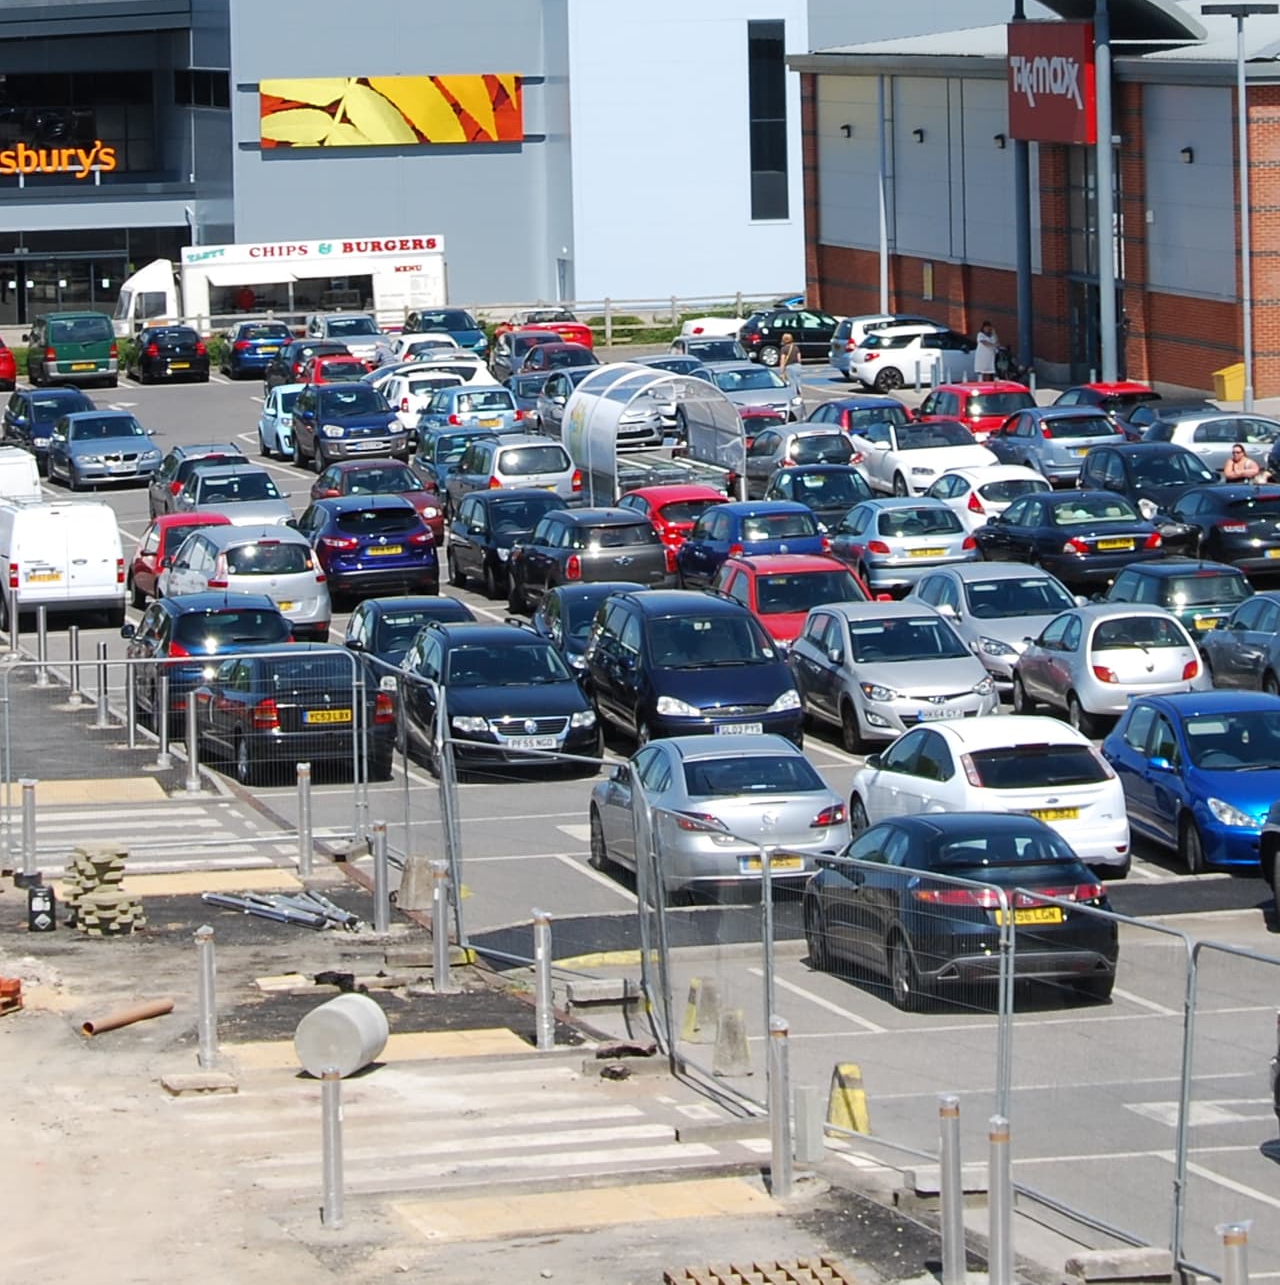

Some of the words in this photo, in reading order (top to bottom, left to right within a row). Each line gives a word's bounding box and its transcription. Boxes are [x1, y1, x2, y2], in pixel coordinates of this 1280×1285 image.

[249, 245, 308, 258] CHIPS
[318, 243, 333, 255] &
[341, 238, 437, 254] BURGERS
[394, 265, 422, 273] MENU
[512, 739, 534, 748] PF55
